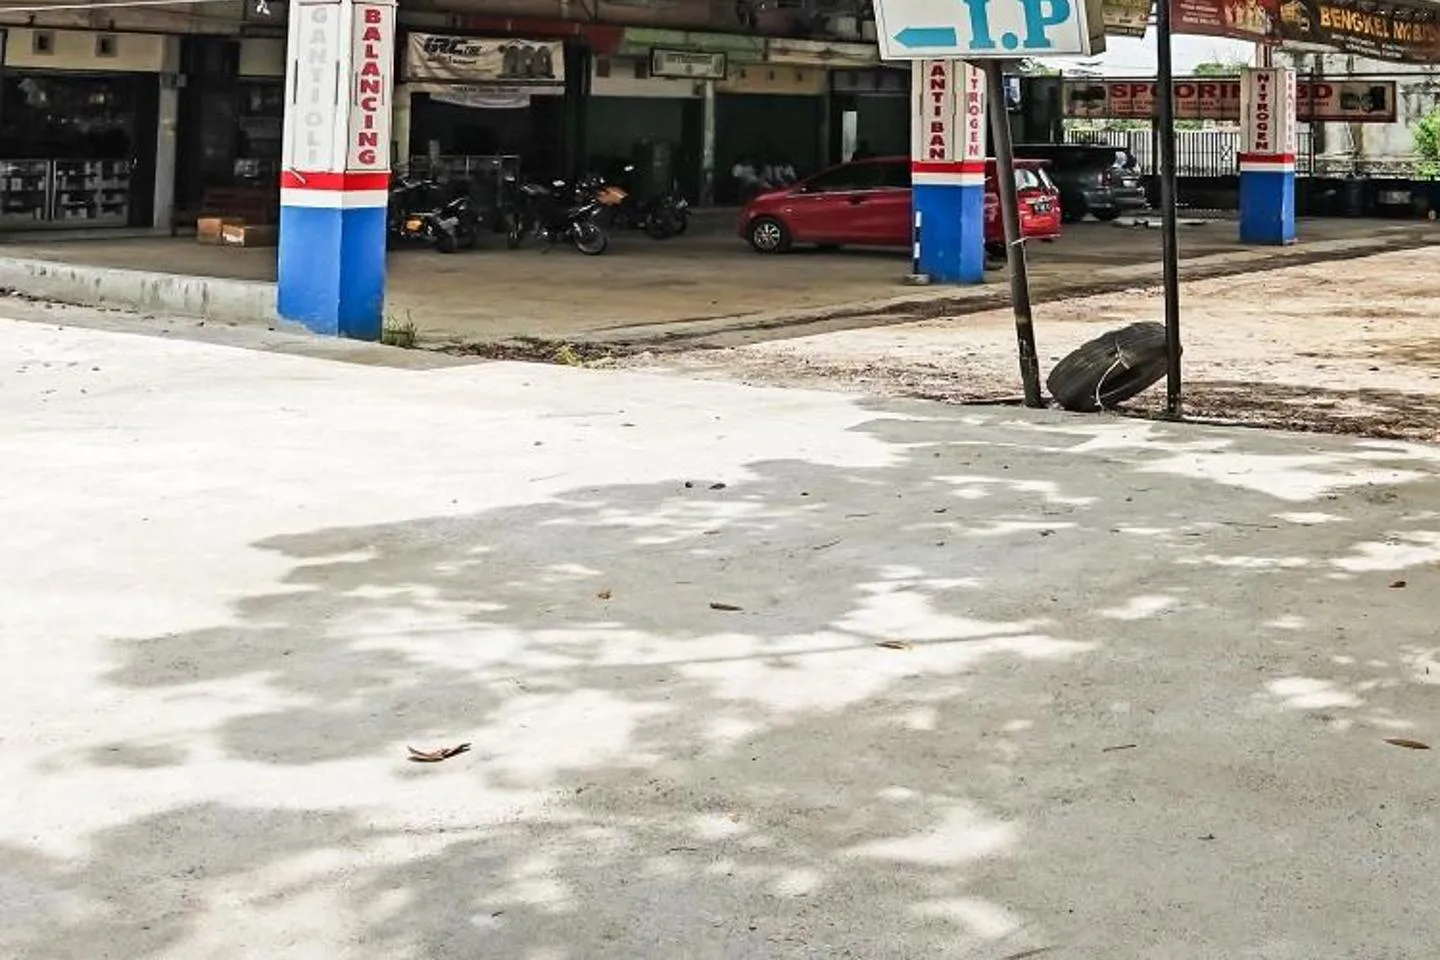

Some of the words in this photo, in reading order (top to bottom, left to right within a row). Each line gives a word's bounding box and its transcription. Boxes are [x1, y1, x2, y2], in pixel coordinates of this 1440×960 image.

[1320, 6, 1390, 38] BENGKEL
[308, 7, 327, 103] GANTI
[358, 9, 382, 165] BALANCING
[930, 59, 946, 116] ANTI
[969, 67, 980, 156] ITROGEN
[1109, 83, 1241, 99] SPORI
[1256, 73, 1270, 150] NITROGEN
[305, 112, 322, 164] OLI
[929, 122, 945, 160] BAN
